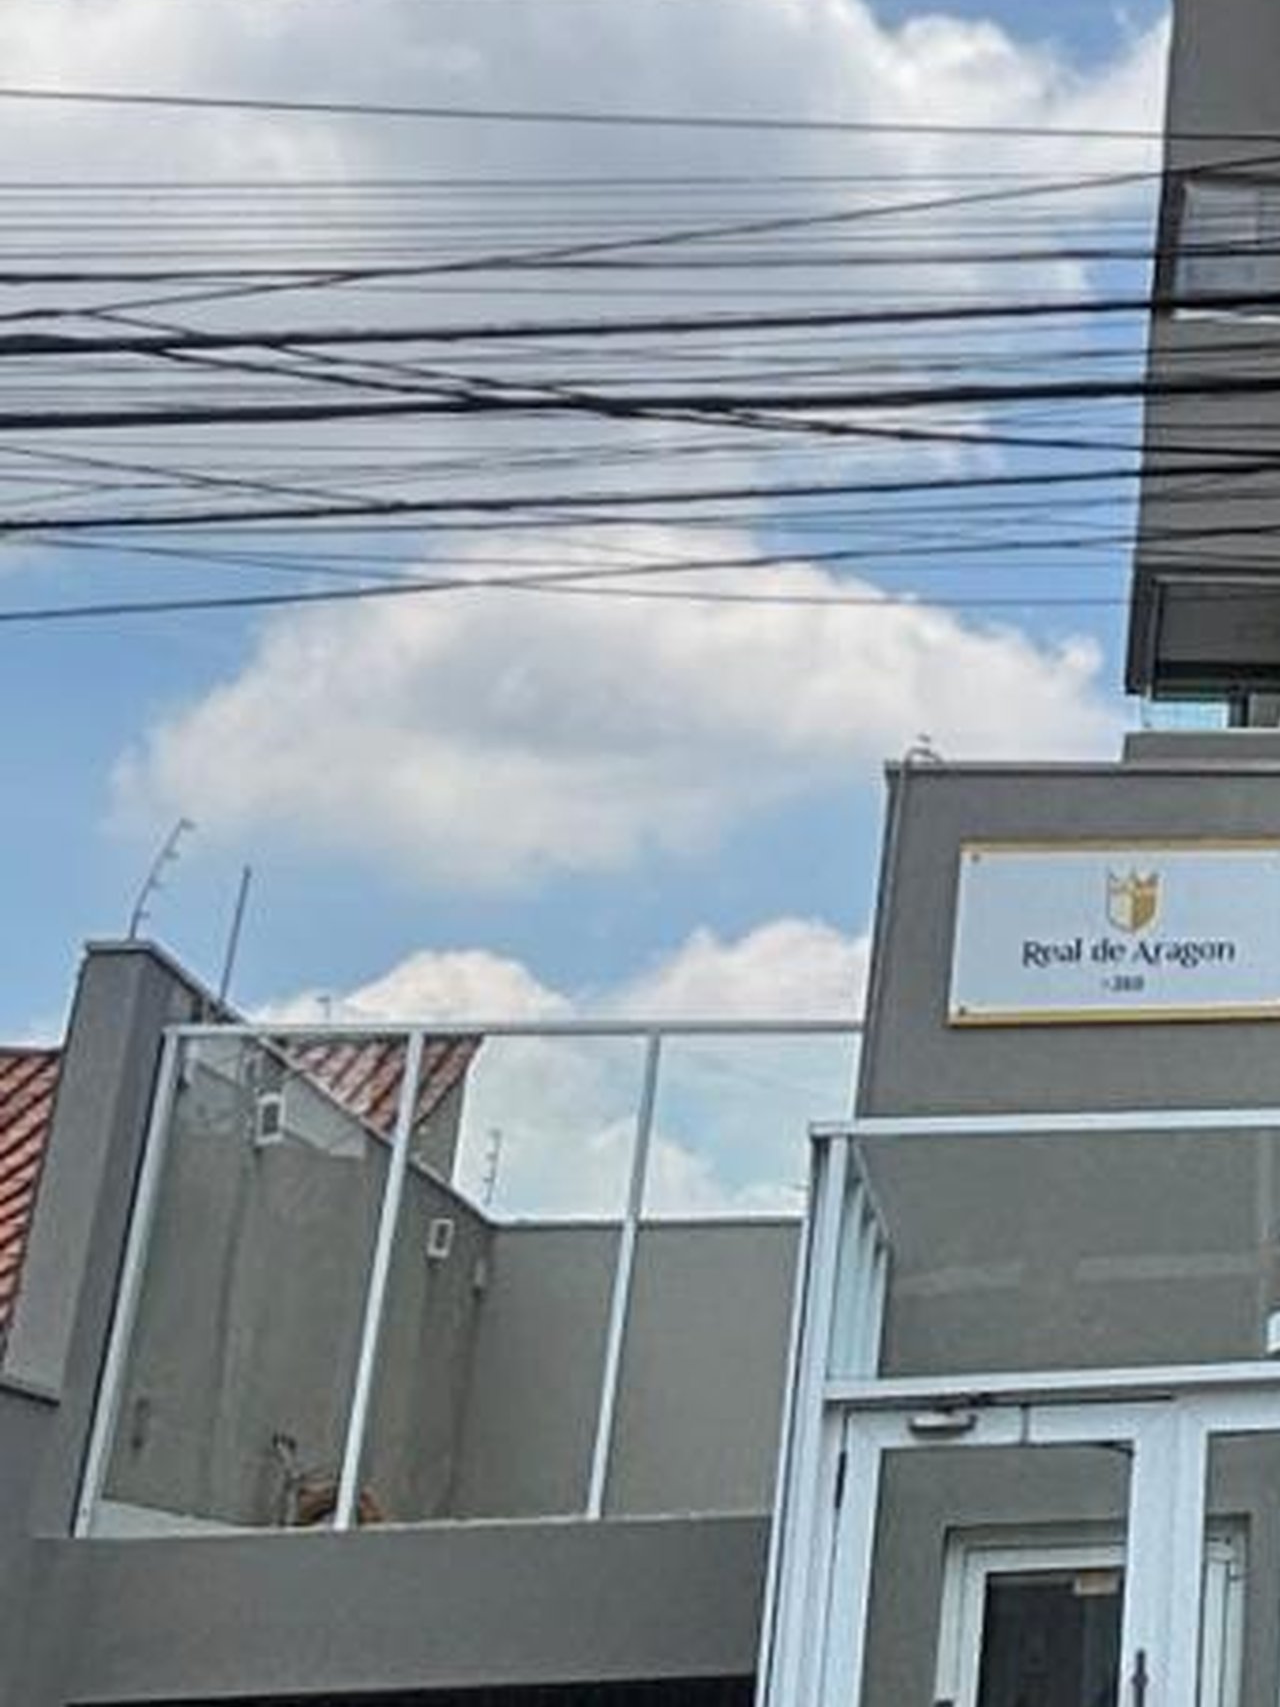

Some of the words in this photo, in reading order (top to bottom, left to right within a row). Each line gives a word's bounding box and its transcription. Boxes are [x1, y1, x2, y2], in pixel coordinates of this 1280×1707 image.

[1022, 938, 1082, 968] Real
[1090, 938, 1127, 964] de
[1131, 940, 1235, 968] Aragon
